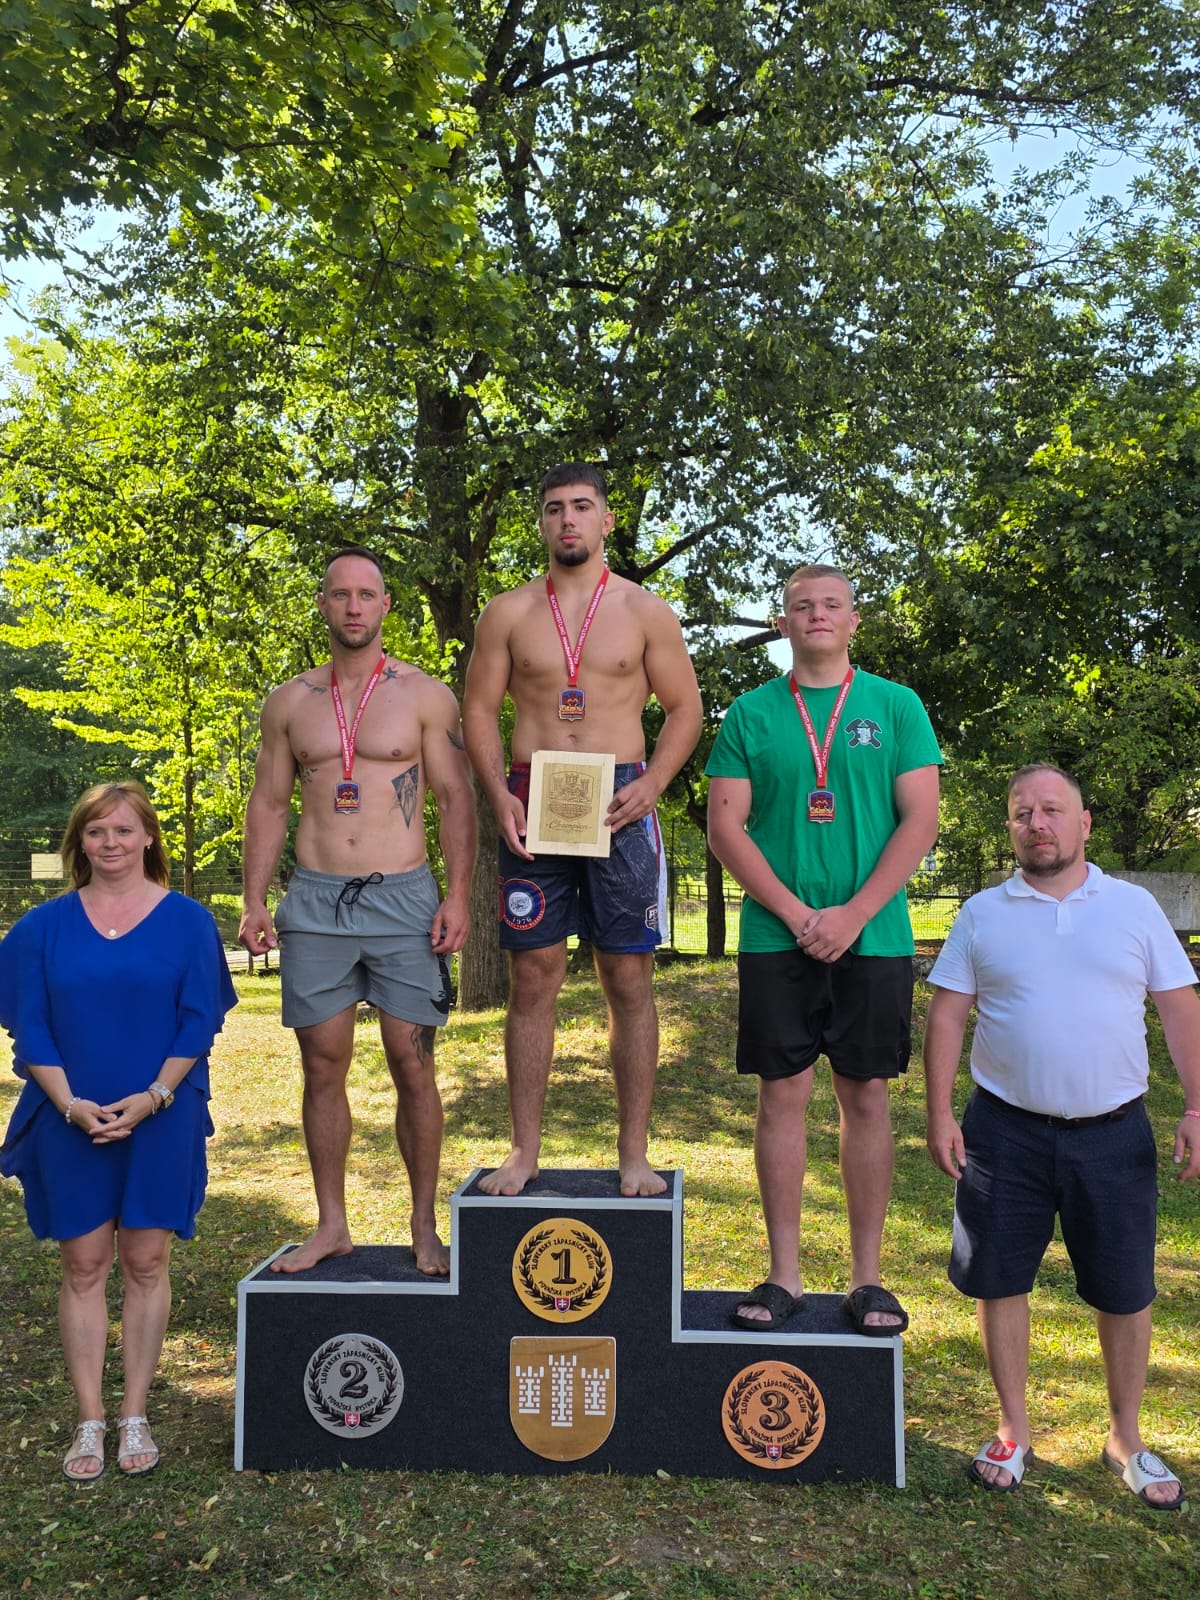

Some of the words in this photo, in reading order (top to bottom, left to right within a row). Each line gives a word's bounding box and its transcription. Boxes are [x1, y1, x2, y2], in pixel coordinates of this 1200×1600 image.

[551, 1248, 577, 1284] 1
[586, 1252, 594, 1270] KLUB
[339, 1360, 368, 1398] 2
[376, 1365, 385, 1382] KLUB
[759, 1390, 792, 1431] 3
[798, 1396, 807, 1413] KLUB
